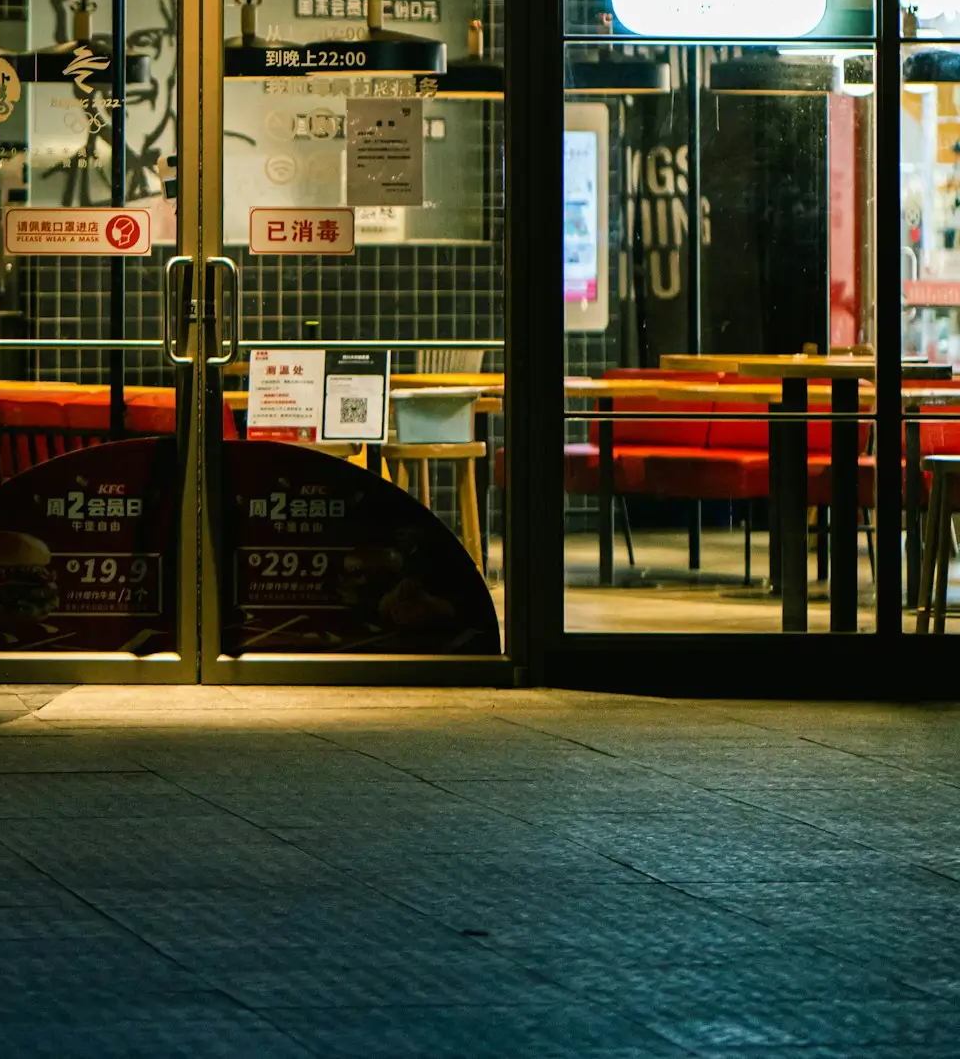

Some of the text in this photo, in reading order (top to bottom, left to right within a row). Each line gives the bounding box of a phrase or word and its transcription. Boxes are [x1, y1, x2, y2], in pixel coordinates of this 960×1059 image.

[265, 50, 367, 68] 到晚上22:00
[17, 221, 99, 232] 请佩戴口罩进店
[267, 220, 340, 242] 已消毒
[98, 483, 125, 495] KFC
[300, 485, 327, 495] KFC
